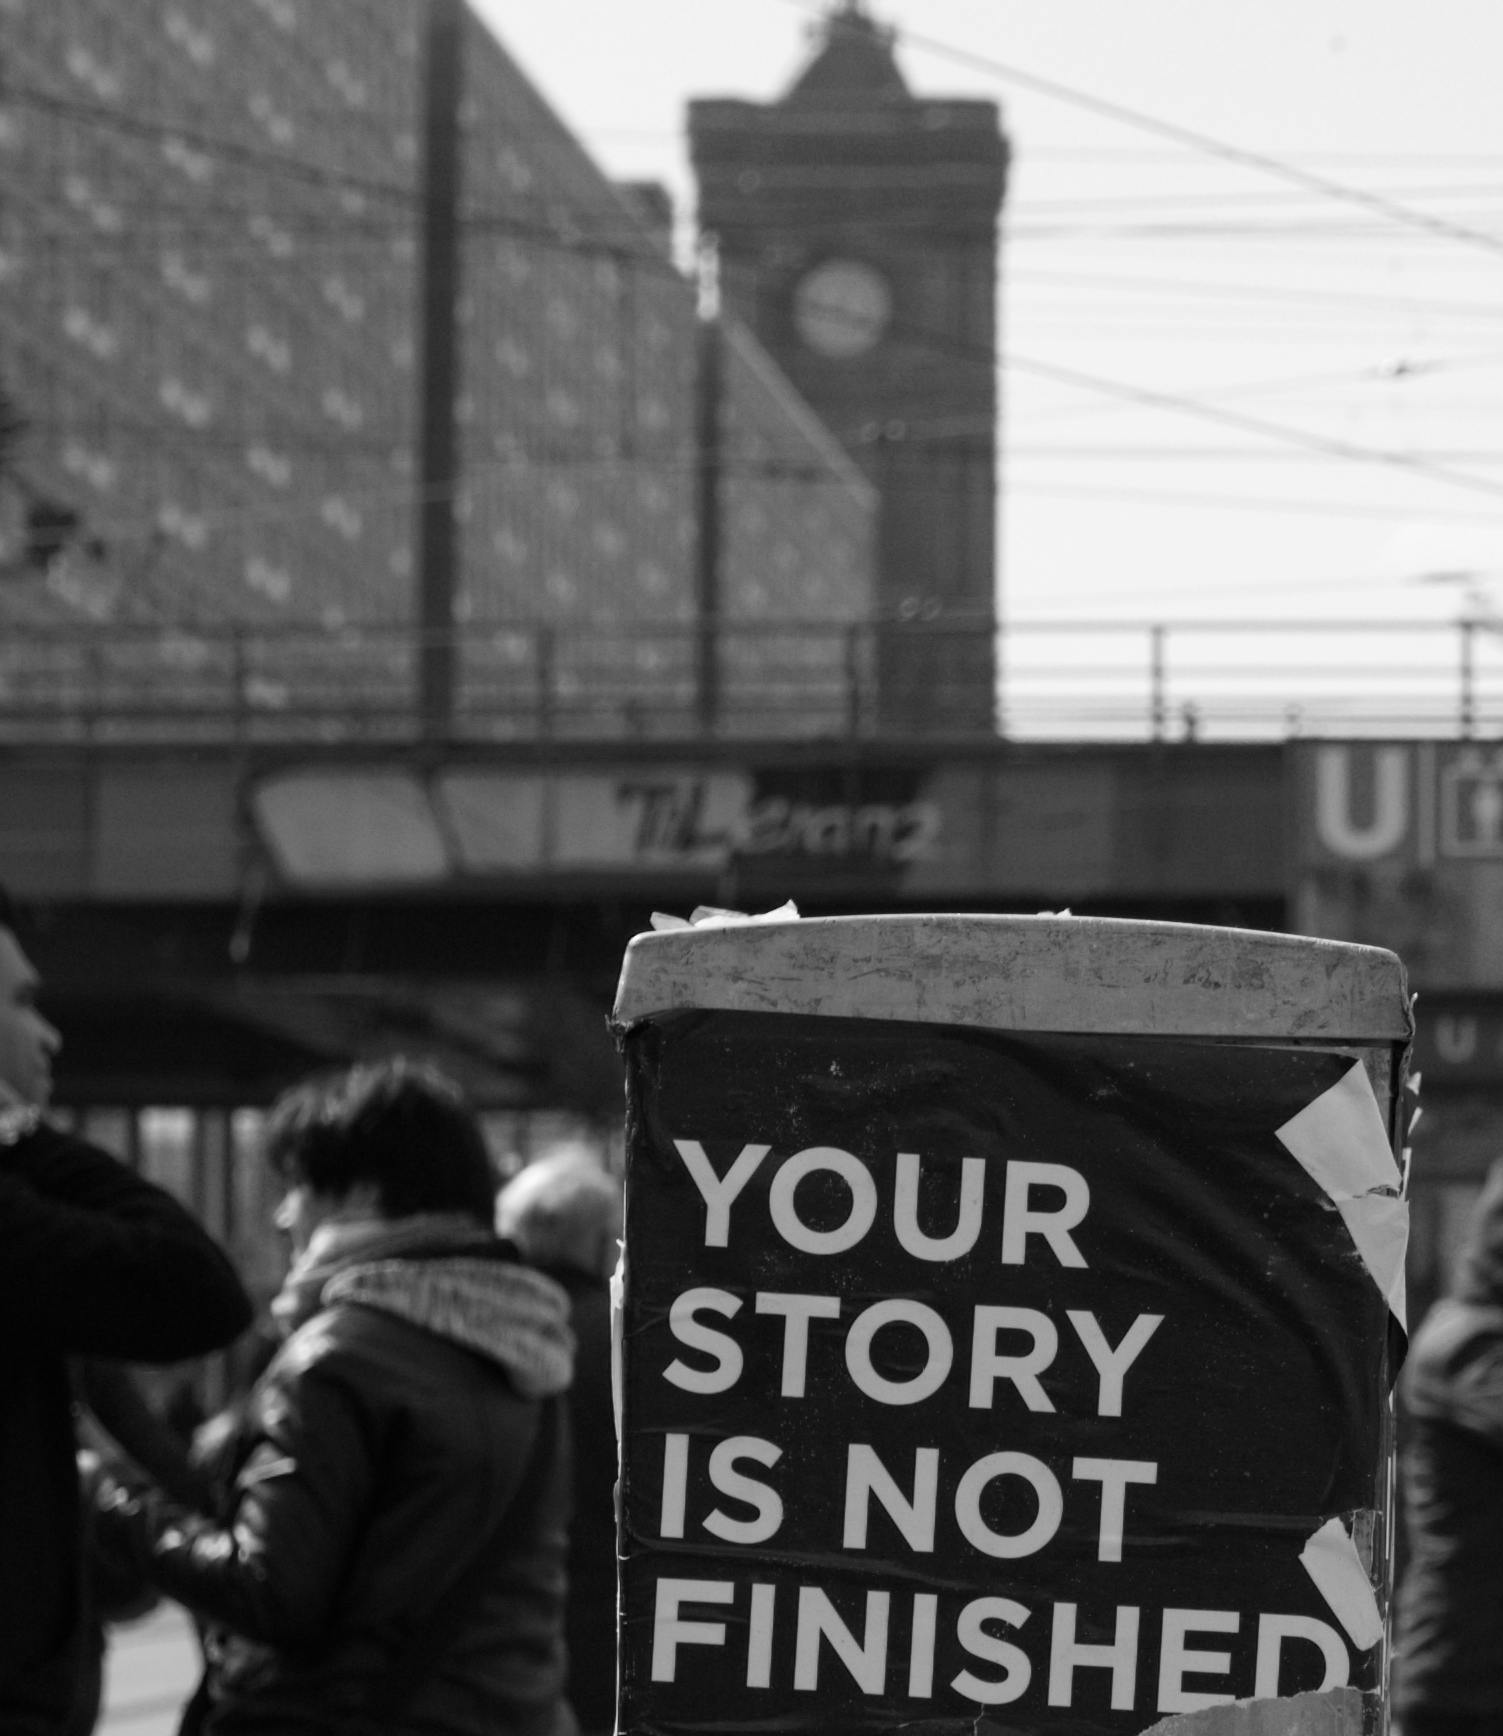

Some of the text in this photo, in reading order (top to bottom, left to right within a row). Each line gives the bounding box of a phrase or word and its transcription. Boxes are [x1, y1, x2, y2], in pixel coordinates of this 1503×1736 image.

[674, 1139, 1091, 1269] YOUR
[662, 1287, 1165, 1418] STORY
[659, 1433, 1159, 1563] IS NOT
[651, 1577, 1352, 1717] FINISHED
